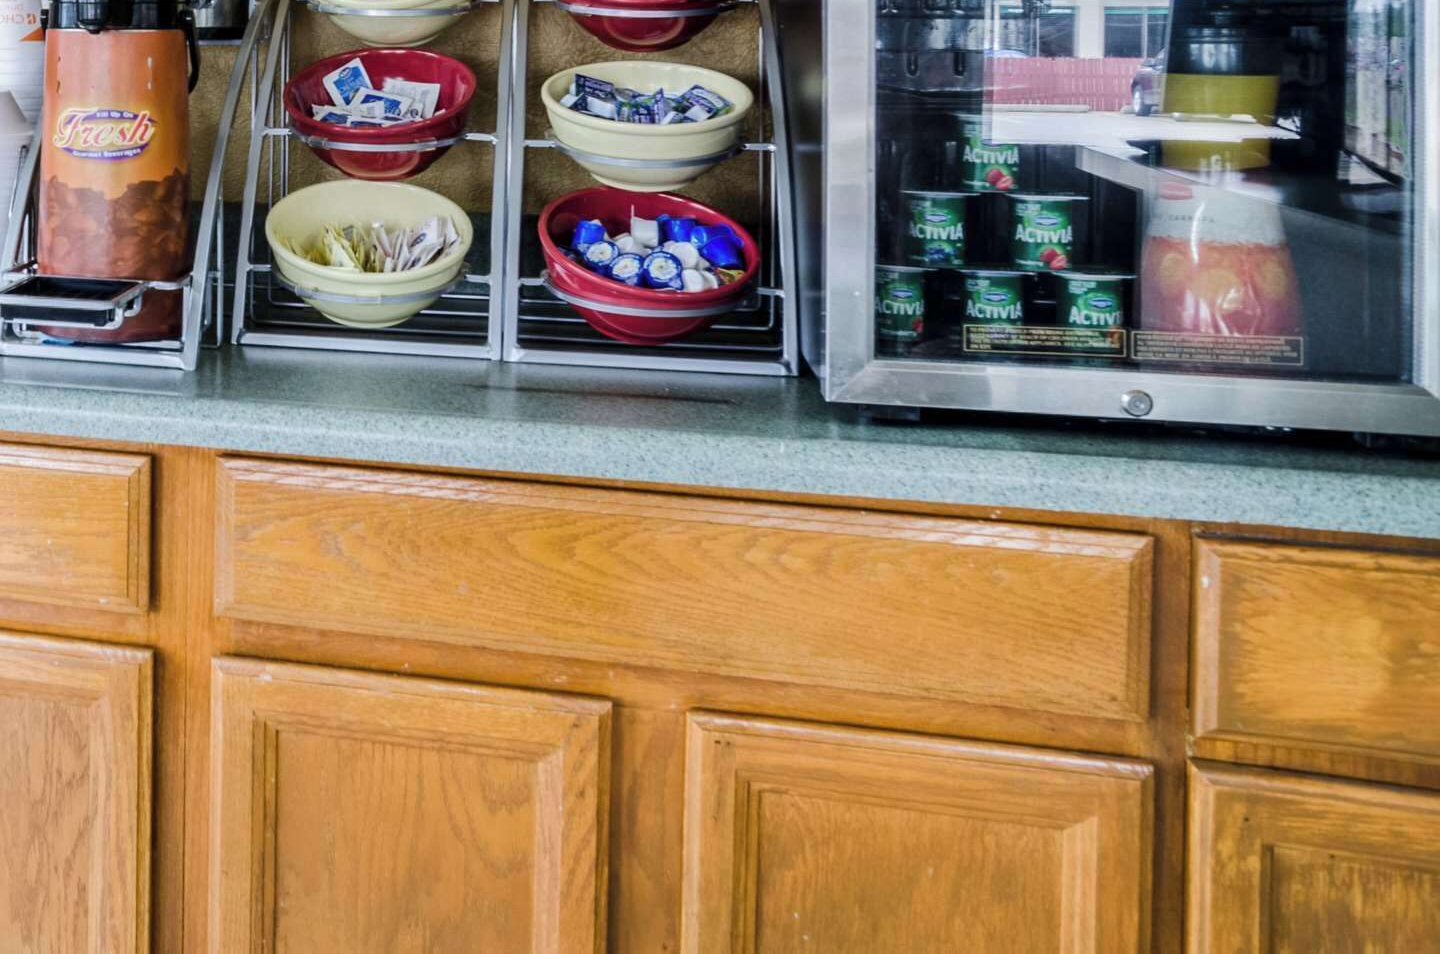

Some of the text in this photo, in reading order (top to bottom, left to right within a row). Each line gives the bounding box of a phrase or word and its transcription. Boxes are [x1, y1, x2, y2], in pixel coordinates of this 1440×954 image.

[53, 106, 155, 148] Fresh
[963, 145, 1019, 164] ACTIVIA
[910, 222, 964, 240] ACTIVIA
[1016, 224, 1073, 243] ACTIVIA
[966, 299, 1023, 319] ACTIVIA
